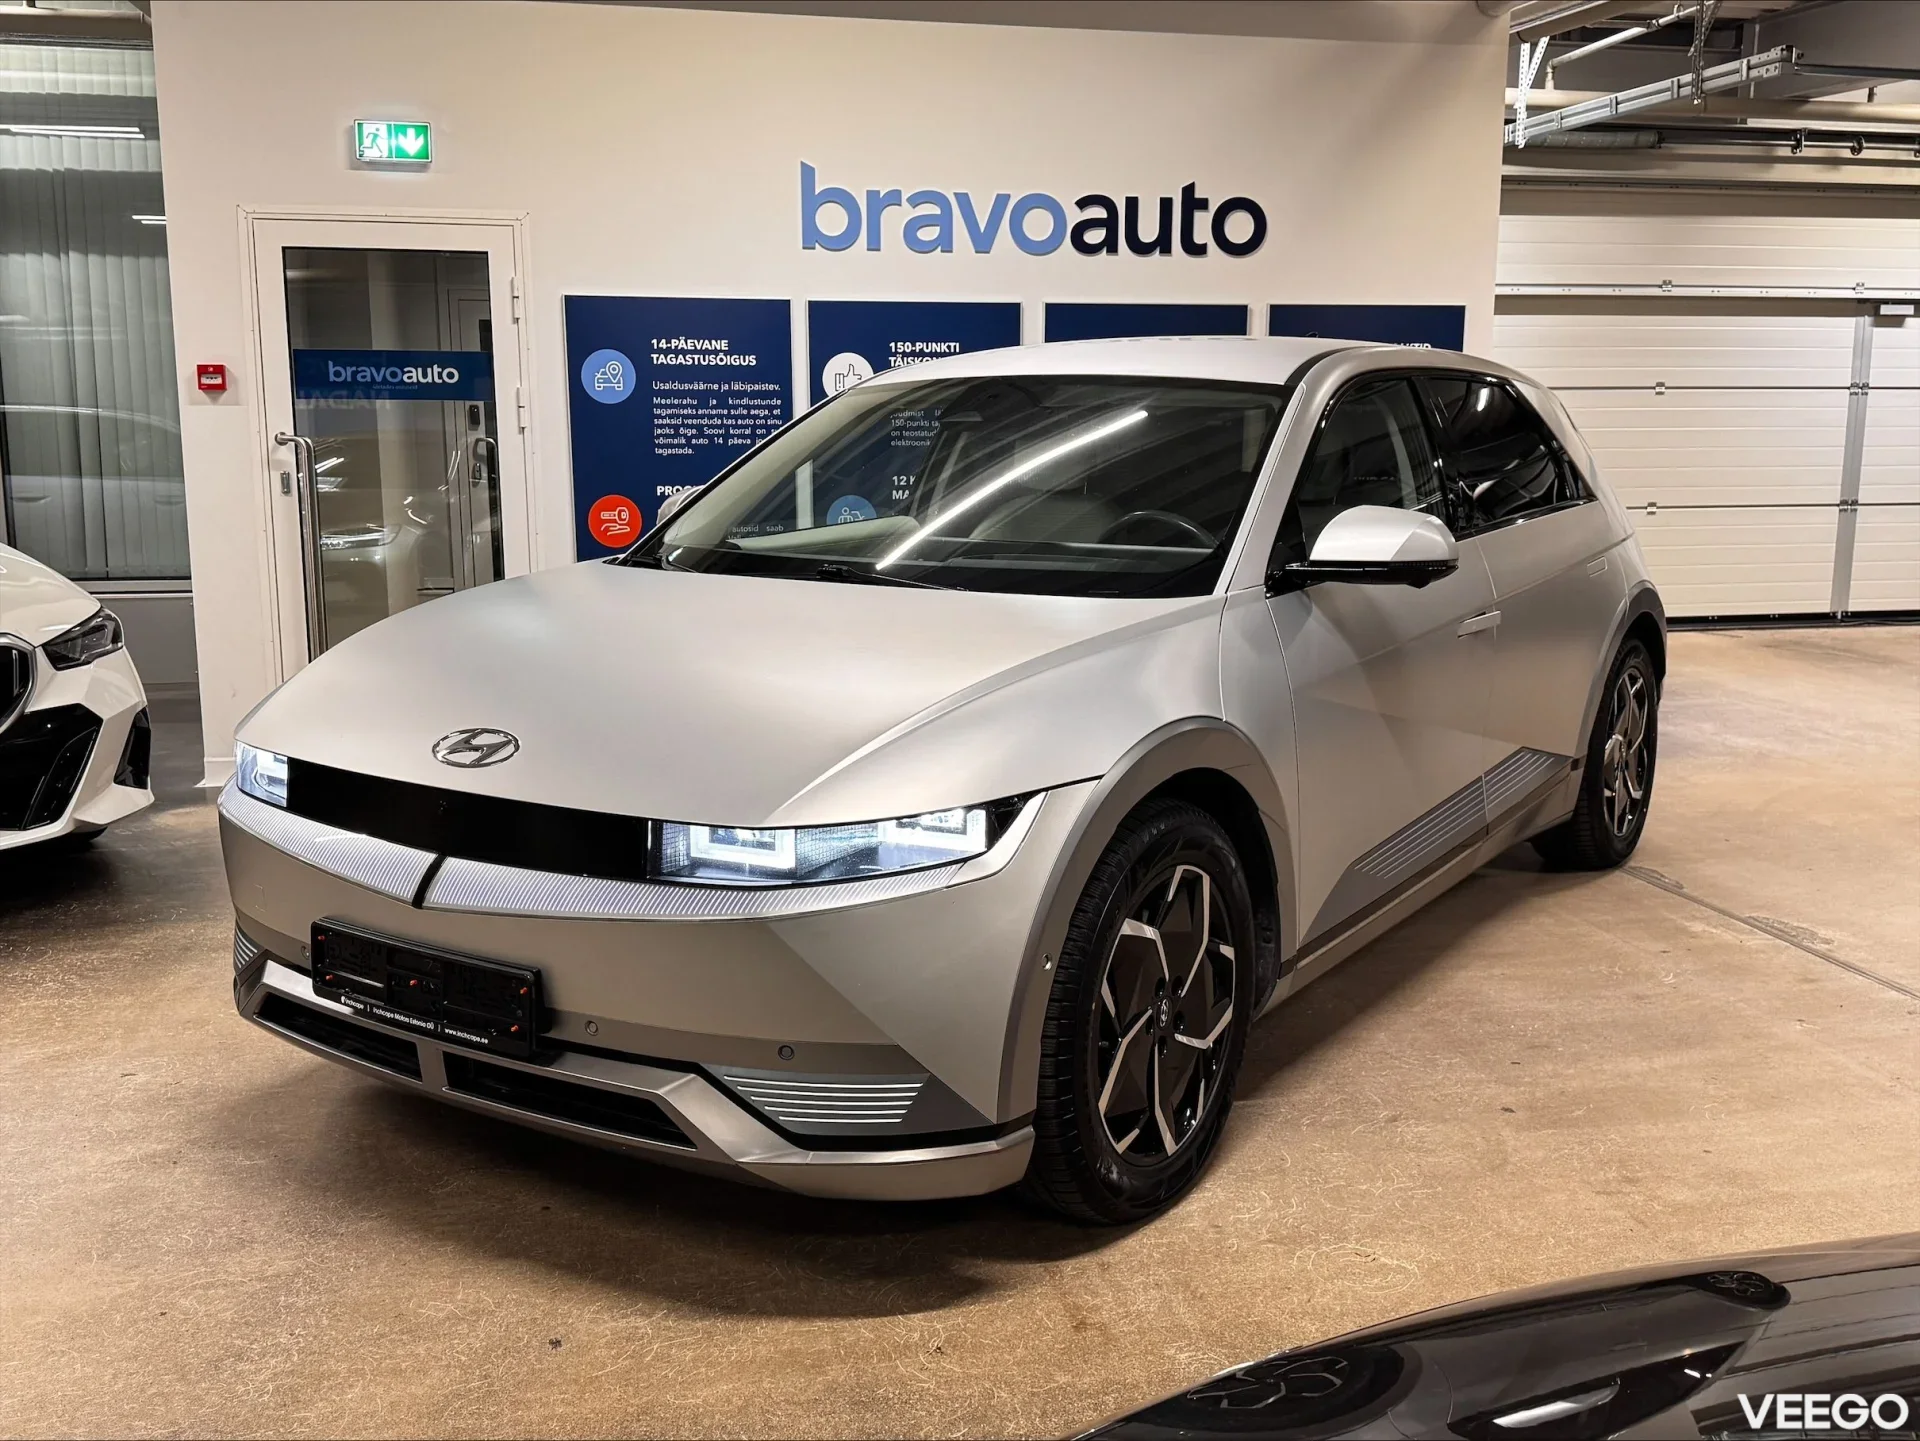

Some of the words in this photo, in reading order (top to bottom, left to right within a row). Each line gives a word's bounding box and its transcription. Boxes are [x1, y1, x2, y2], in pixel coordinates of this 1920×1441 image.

[800, 160, 1268, 257] bravoauto
[651, 336, 729, 350] 14-PÄEVANE
[889, 342, 960, 352] 150-PUNKTI
[650, 352, 757, 366] TAGASTUSÕIGUS
[889, 354, 942, 367] TÄISK
[328, 360, 459, 383] bravoauto
[652, 380, 719, 391] Usaldusväärne
[721, 381, 729, 392] ja
[731, 381, 781, 393] läbipaistev.
[653, 397, 698, 405] Meelerahu
[709, 397, 717, 407] ja
[728, 397, 781, 406] kindlustunde
[653, 407, 697, 416] tagamiseks
[730, 407, 748, 416] sulle
[750, 409, 771, 417] aega,
[654, 416, 682, 426] saaksid
[683, 417, 722, 426] veenduda
[723, 417, 736, 426] kas
[737, 418, 754, 426] auto
[767, 418, 782, 426] sinu
[891, 419, 929, 428] 150-punkti
[653, 427, 674, 437] jaoks
[679, 427, 699, 437] õige.
[703, 427, 725, 435] Soovi
[729, 427, 751, 435] korral
[654, 437, 686, 445] võimalik
[728, 437, 751, 447] päeva
[655, 447, 695, 456] tagastada.
[892, 475, 907, 486] 12
[766, 524, 784, 532] saab
[373, 1006, 394, 1019] Inchcape
[444, 1027, 489, 1044] www.inchcape.ee
